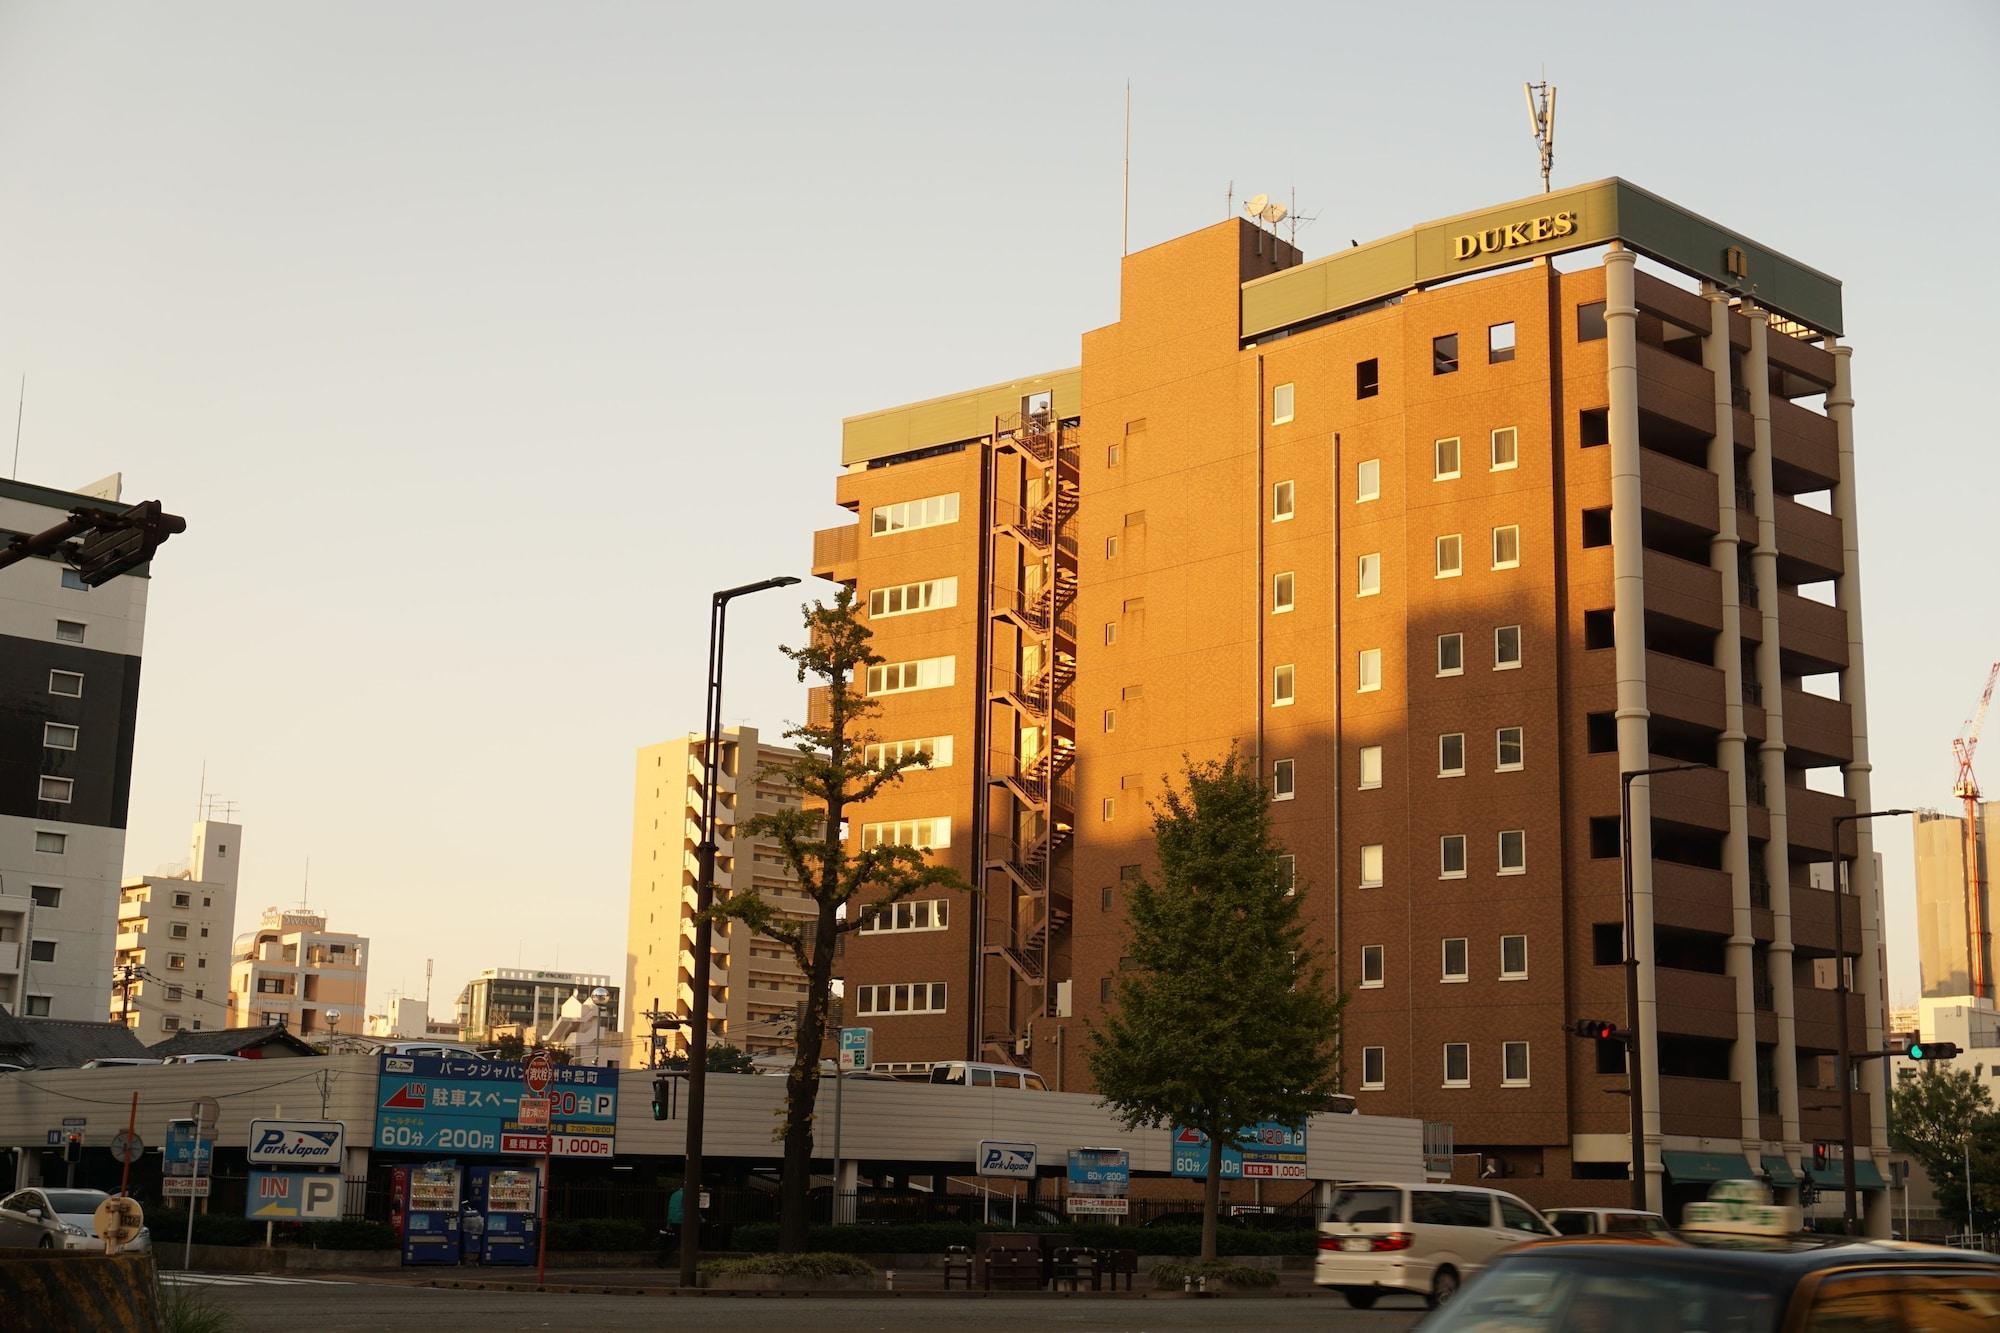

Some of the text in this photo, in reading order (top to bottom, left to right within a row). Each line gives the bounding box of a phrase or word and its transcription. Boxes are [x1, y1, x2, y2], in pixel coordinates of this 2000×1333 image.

[1453, 210, 1578, 260] DUKES
[411, 1083, 426, 1096] IN
[599, 1096, 609, 1114] P
[260, 1176, 289, 1198] IN
[306, 1182, 334, 1212] P
